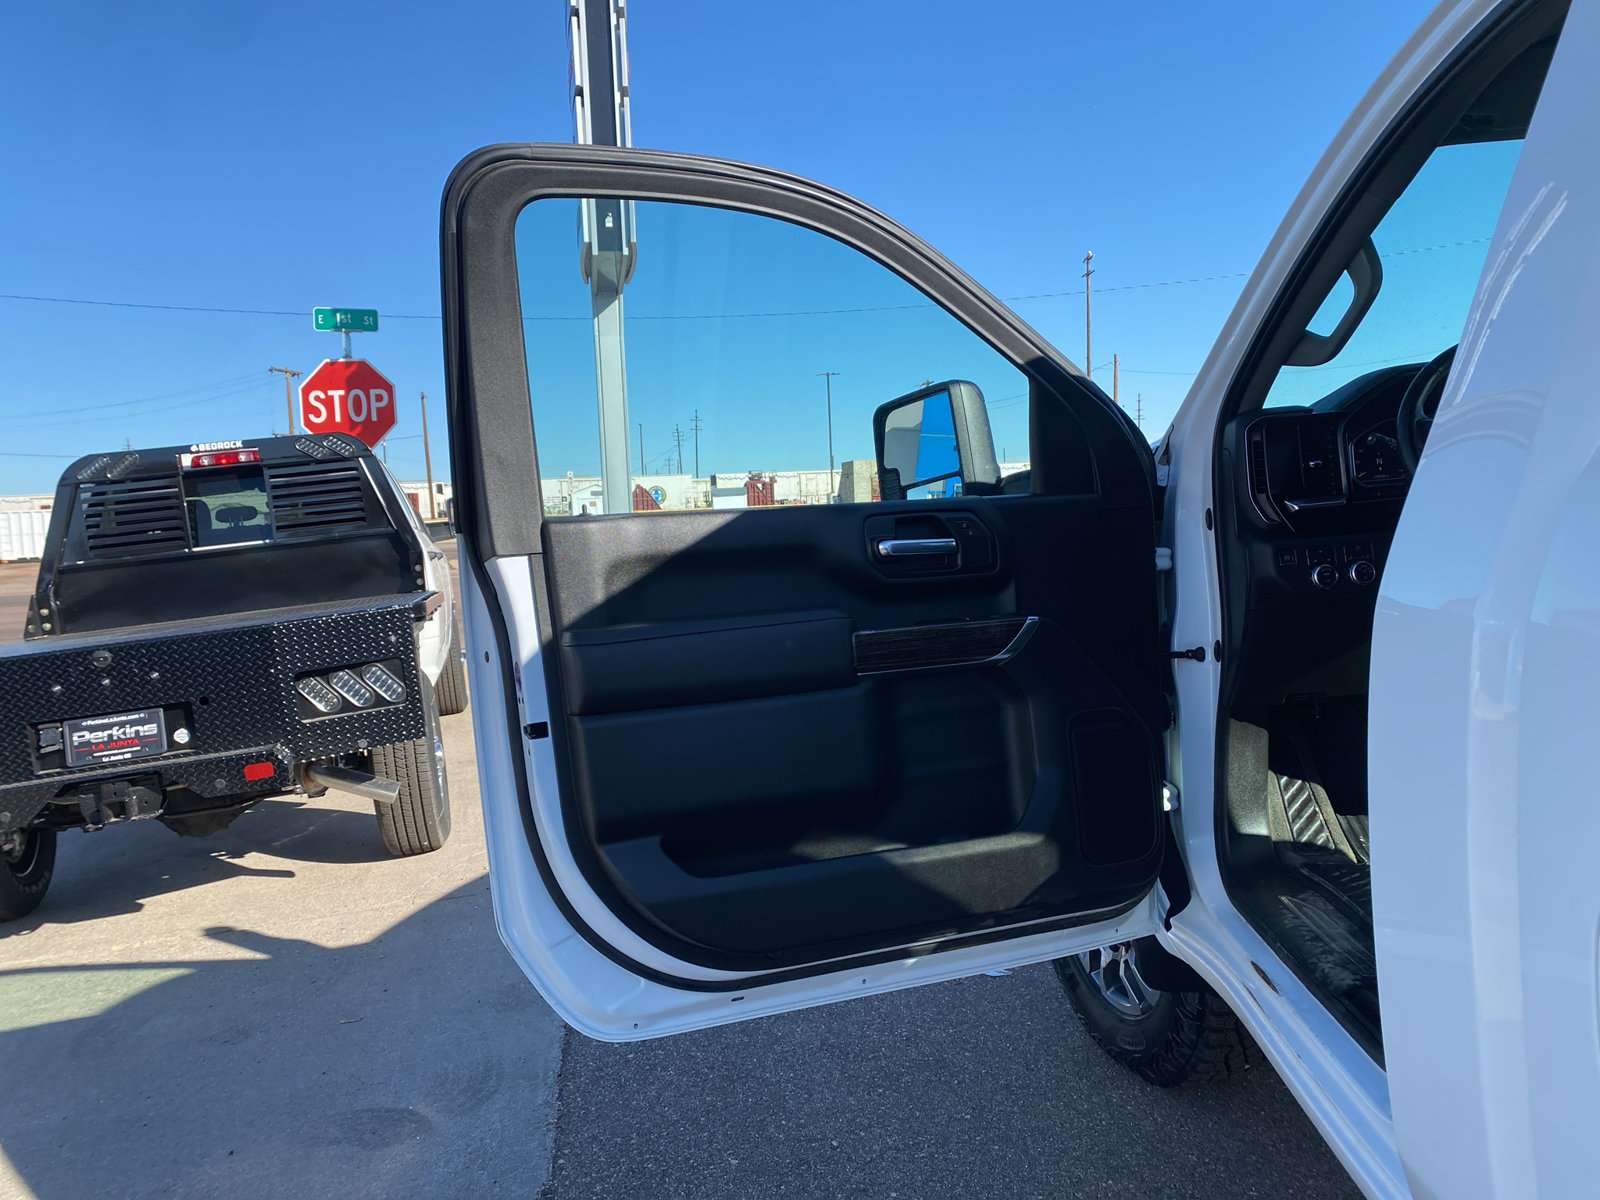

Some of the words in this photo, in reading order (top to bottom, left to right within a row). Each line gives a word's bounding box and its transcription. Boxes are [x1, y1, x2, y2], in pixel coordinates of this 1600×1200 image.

[318, 314, 324, 324] E
[335, 312, 352, 326] 1st
[363, 315, 373, 325] St
[308, 388, 389, 424] STOP
[198, 440, 243, 452] BEDROCK
[72, 723, 158, 746] Perkins
[91, 742, 105, 751] LA
[107, 738, 140, 748] JUNTA
